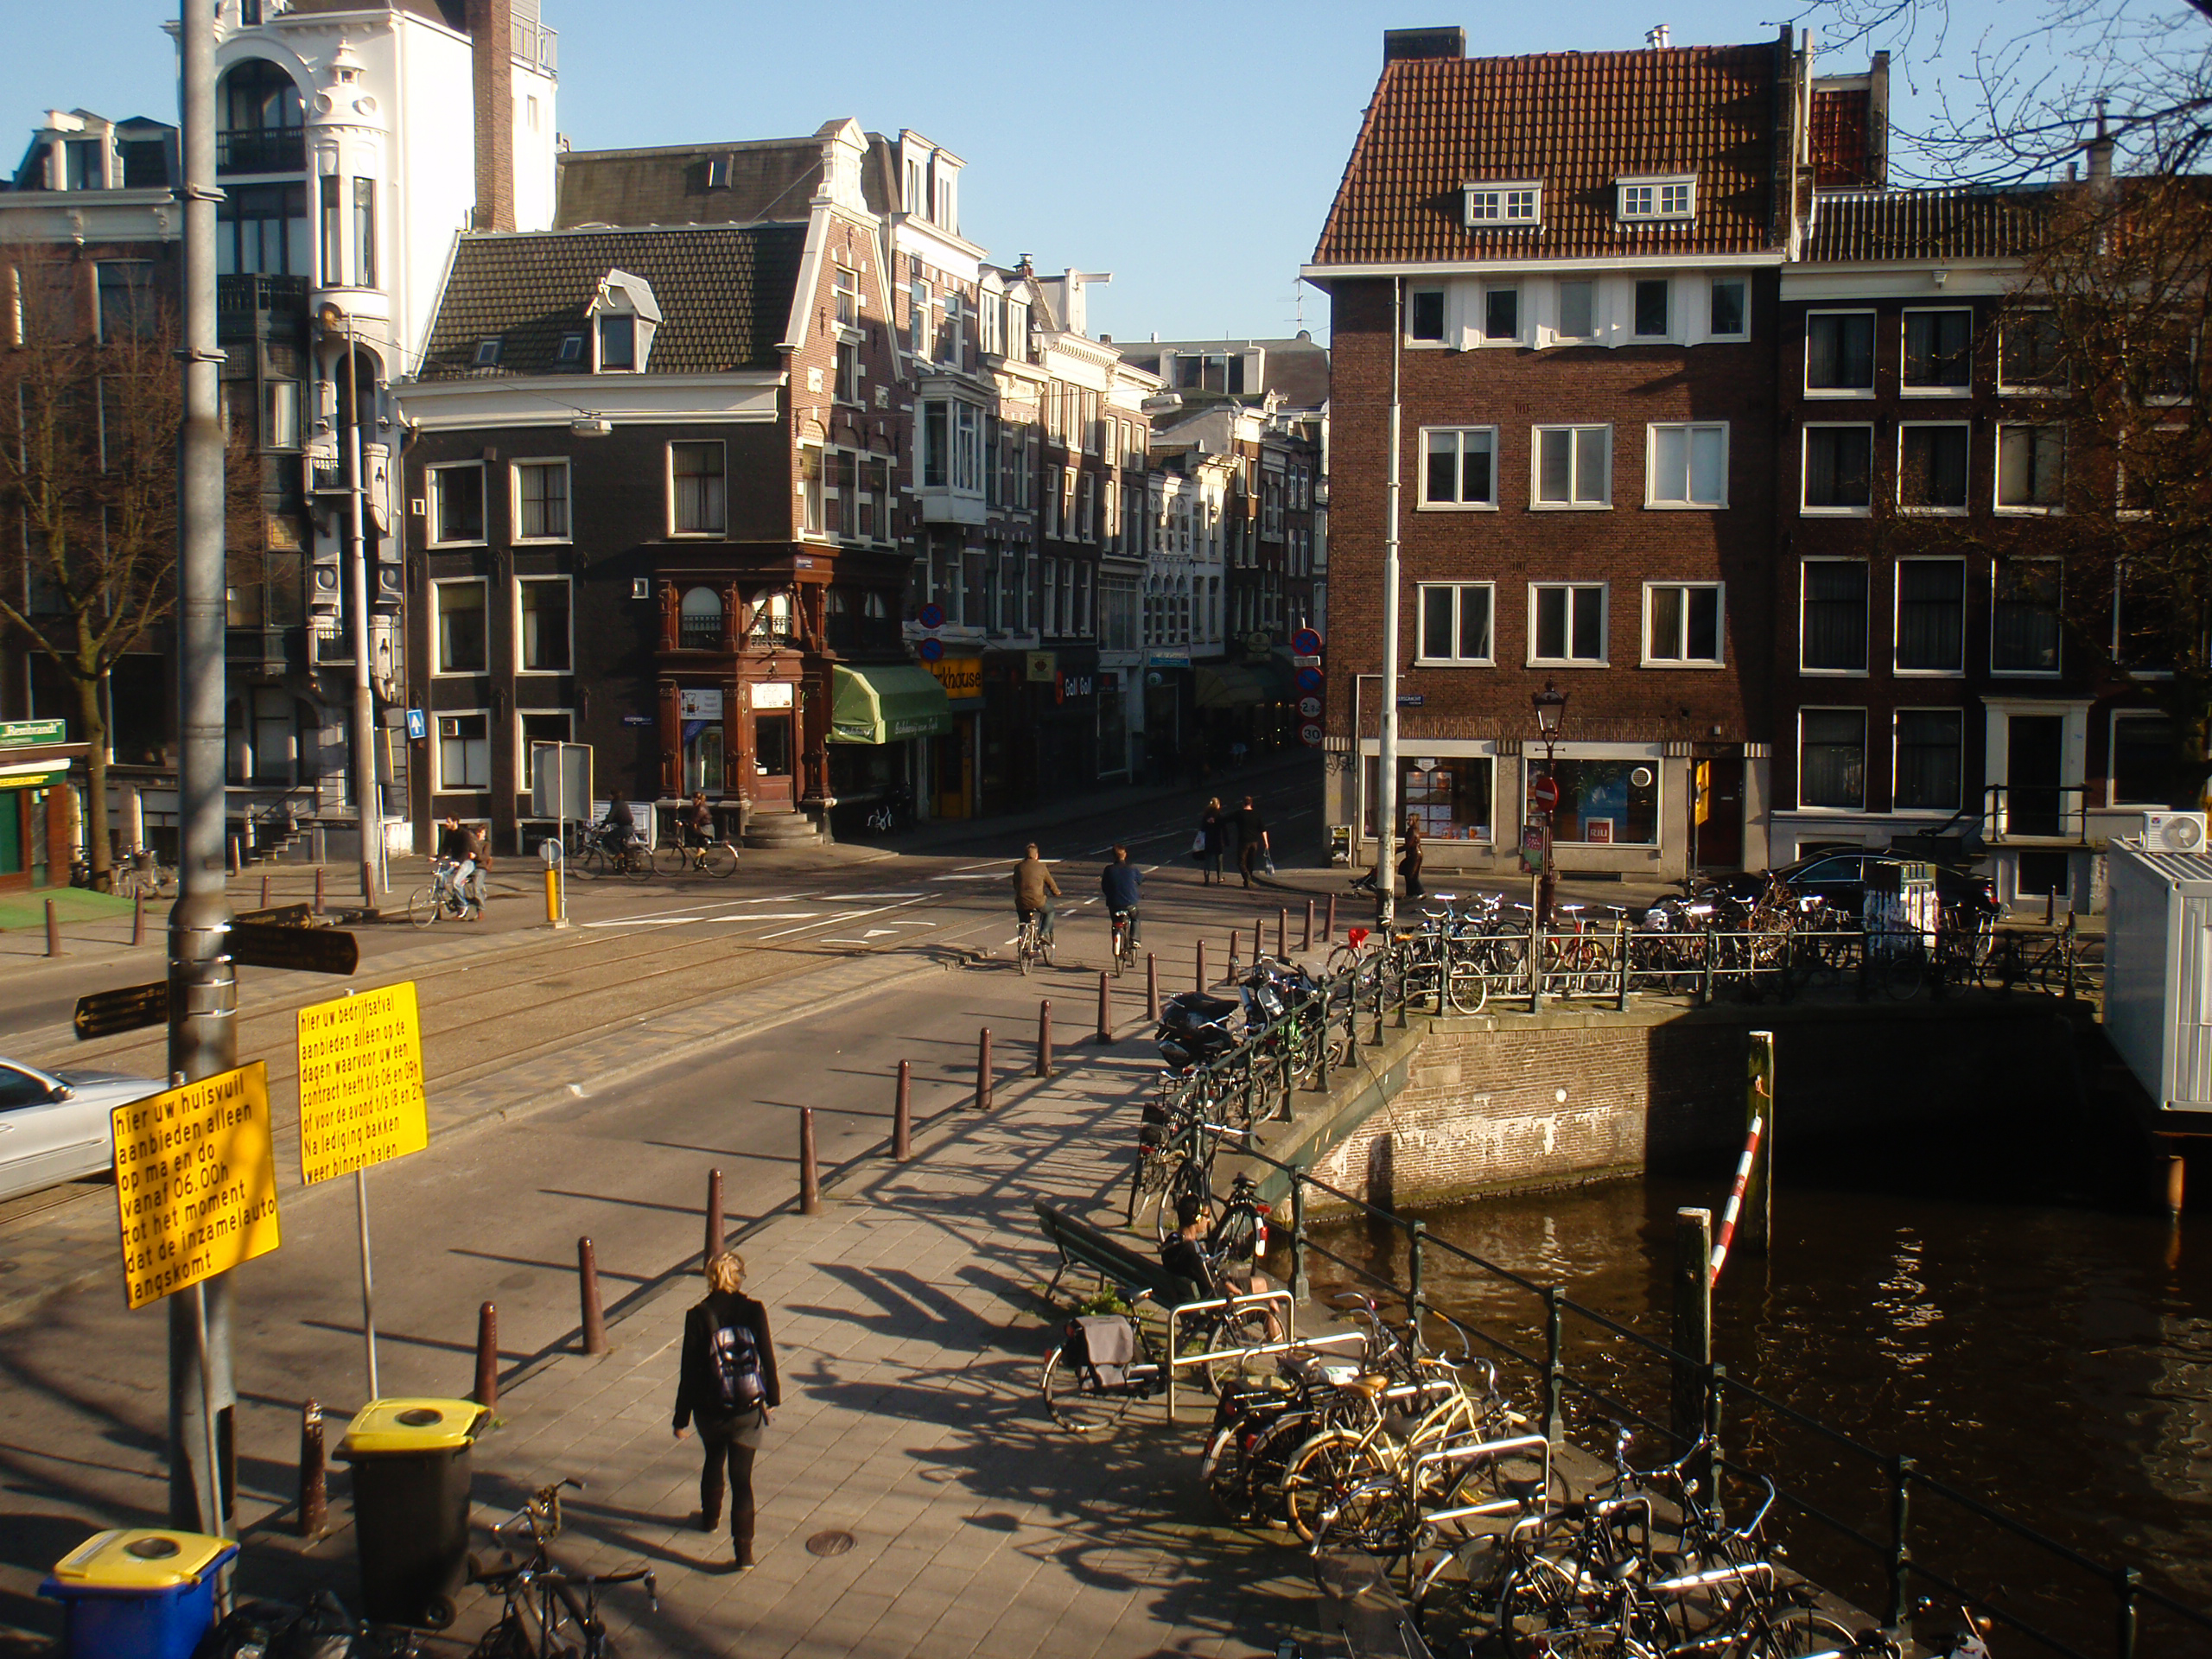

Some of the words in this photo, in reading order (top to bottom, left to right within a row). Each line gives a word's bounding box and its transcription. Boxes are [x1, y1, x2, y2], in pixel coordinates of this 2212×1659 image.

[1065, 677, 1078, 696] Gall
[1304, 729, 1320, 740] 30
[301, 1012, 320, 1033] hier
[323, 1011, 335, 1027] uw
[338, 992, 395, 1025] bedrijfsafval
[302, 1034, 351, 1060] aanbieden
[354, 1025, 381, 1049] alleen
[384, 1021, 393, 1043] op
[396, 1018, 405, 1036] de
[302, 1063, 331, 1086] dagen
[335, 1051, 376, 1075] waarvoor
[379, 1047, 391, 1063] uw
[394, 1042, 409, 1059] een
[302, 1084, 340, 1108] contract
[342, 1073, 365, 1097] heeft
[366, 1069, 379, 1091] t/s
[381, 1066, 391, 1086] 06
[394, 1068, 403, 1083] en
[404, 1059, 419, 1079] 09h
[116, 1109, 148, 1137] hier
[154, 1100, 175, 1122] uw
[181, 1072, 245, 1115] huisvuil
[304, 1113, 313, 1133] of
[315, 1108, 334, 1130] voor
[336, 1103, 346, 1123] de
[349, 1096, 373, 1119] avond
[376, 1090, 389, 1113] t/s
[391, 1088, 398, 1107] 18
[401, 1089, 410, 1104] en
[118, 1121, 201, 1165] aanbieden
[207, 1103, 252, 1134] alleen
[304, 1138, 318, 1158] Na
[321, 1126, 362, 1153] lediging
[365, 1116, 400, 1140] bakken
[121, 1171, 139, 1193] op
[145, 1160, 168, 1183] ma
[175, 1147, 192, 1172] en
[198, 1141, 215, 1163] do
[306, 1163, 330, 1185] weer
[333, 1152, 367, 1176] binnen
[371, 1142, 397, 1163] halen
[122, 1222, 147, 1246] tot
[154, 1206, 178, 1236] het
[185, 1179, 246, 1223] moment
[123, 1182, 168, 1218] vanaf
[174, 1161, 229, 1199] 06.00h
[126, 1248, 152, 1274] dat
[158, 1238, 175, 1261] de
[181, 1198, 276, 1252] inzamelauto
[127, 1249, 212, 1303] langskomt
